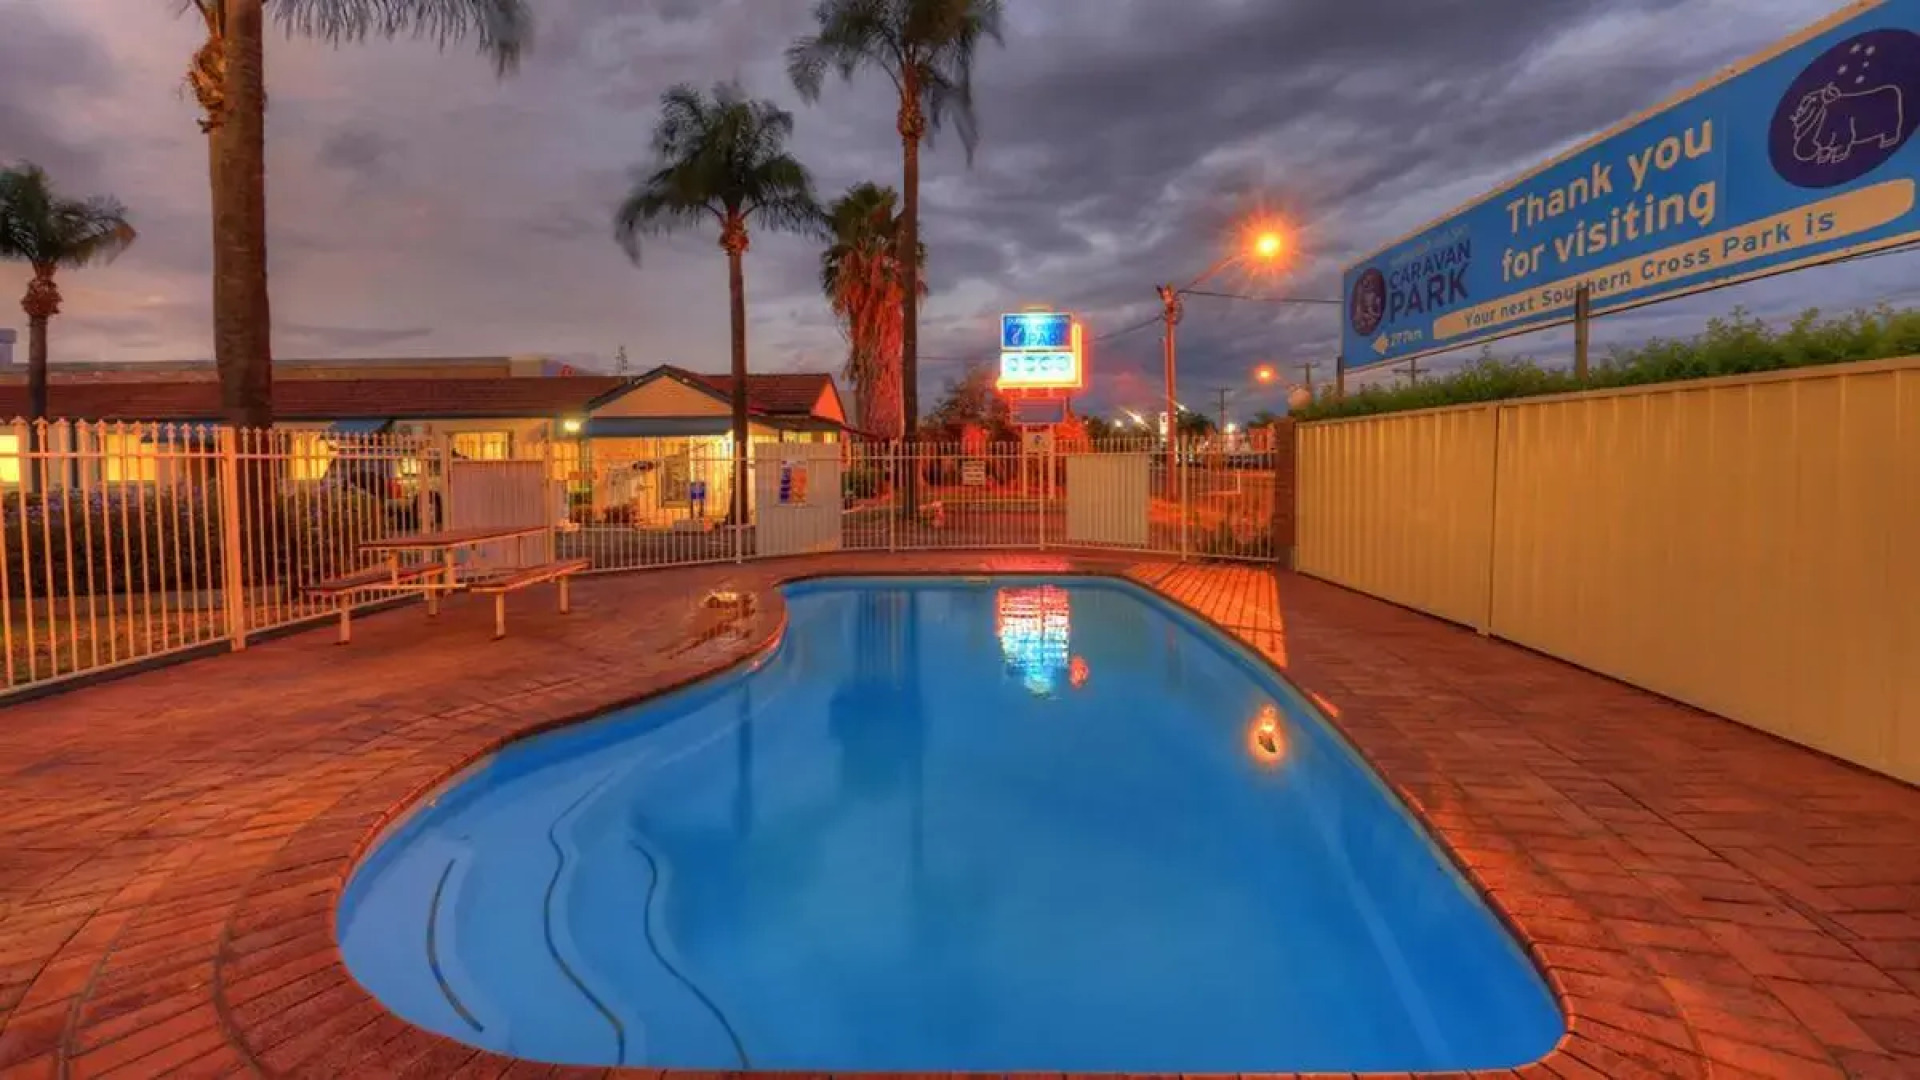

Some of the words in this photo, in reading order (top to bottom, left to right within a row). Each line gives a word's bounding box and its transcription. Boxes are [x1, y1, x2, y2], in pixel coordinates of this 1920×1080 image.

[1506, 160, 1613, 233] Thank
[1627, 118, 1713, 192] you
[1389, 239, 1471, 289] CARAVAN
[1464, 308, 1497, 328] Your
[1500, 297, 1535, 319] next
[1641, 246, 1711, 280] Cross
[1722, 223, 1791, 257] Park
[1805, 210, 1835, 236] is
[1501, 242, 1545, 282] for
[1554, 180, 1716, 263] visiting
[1389, 262, 1471, 323] PARK
